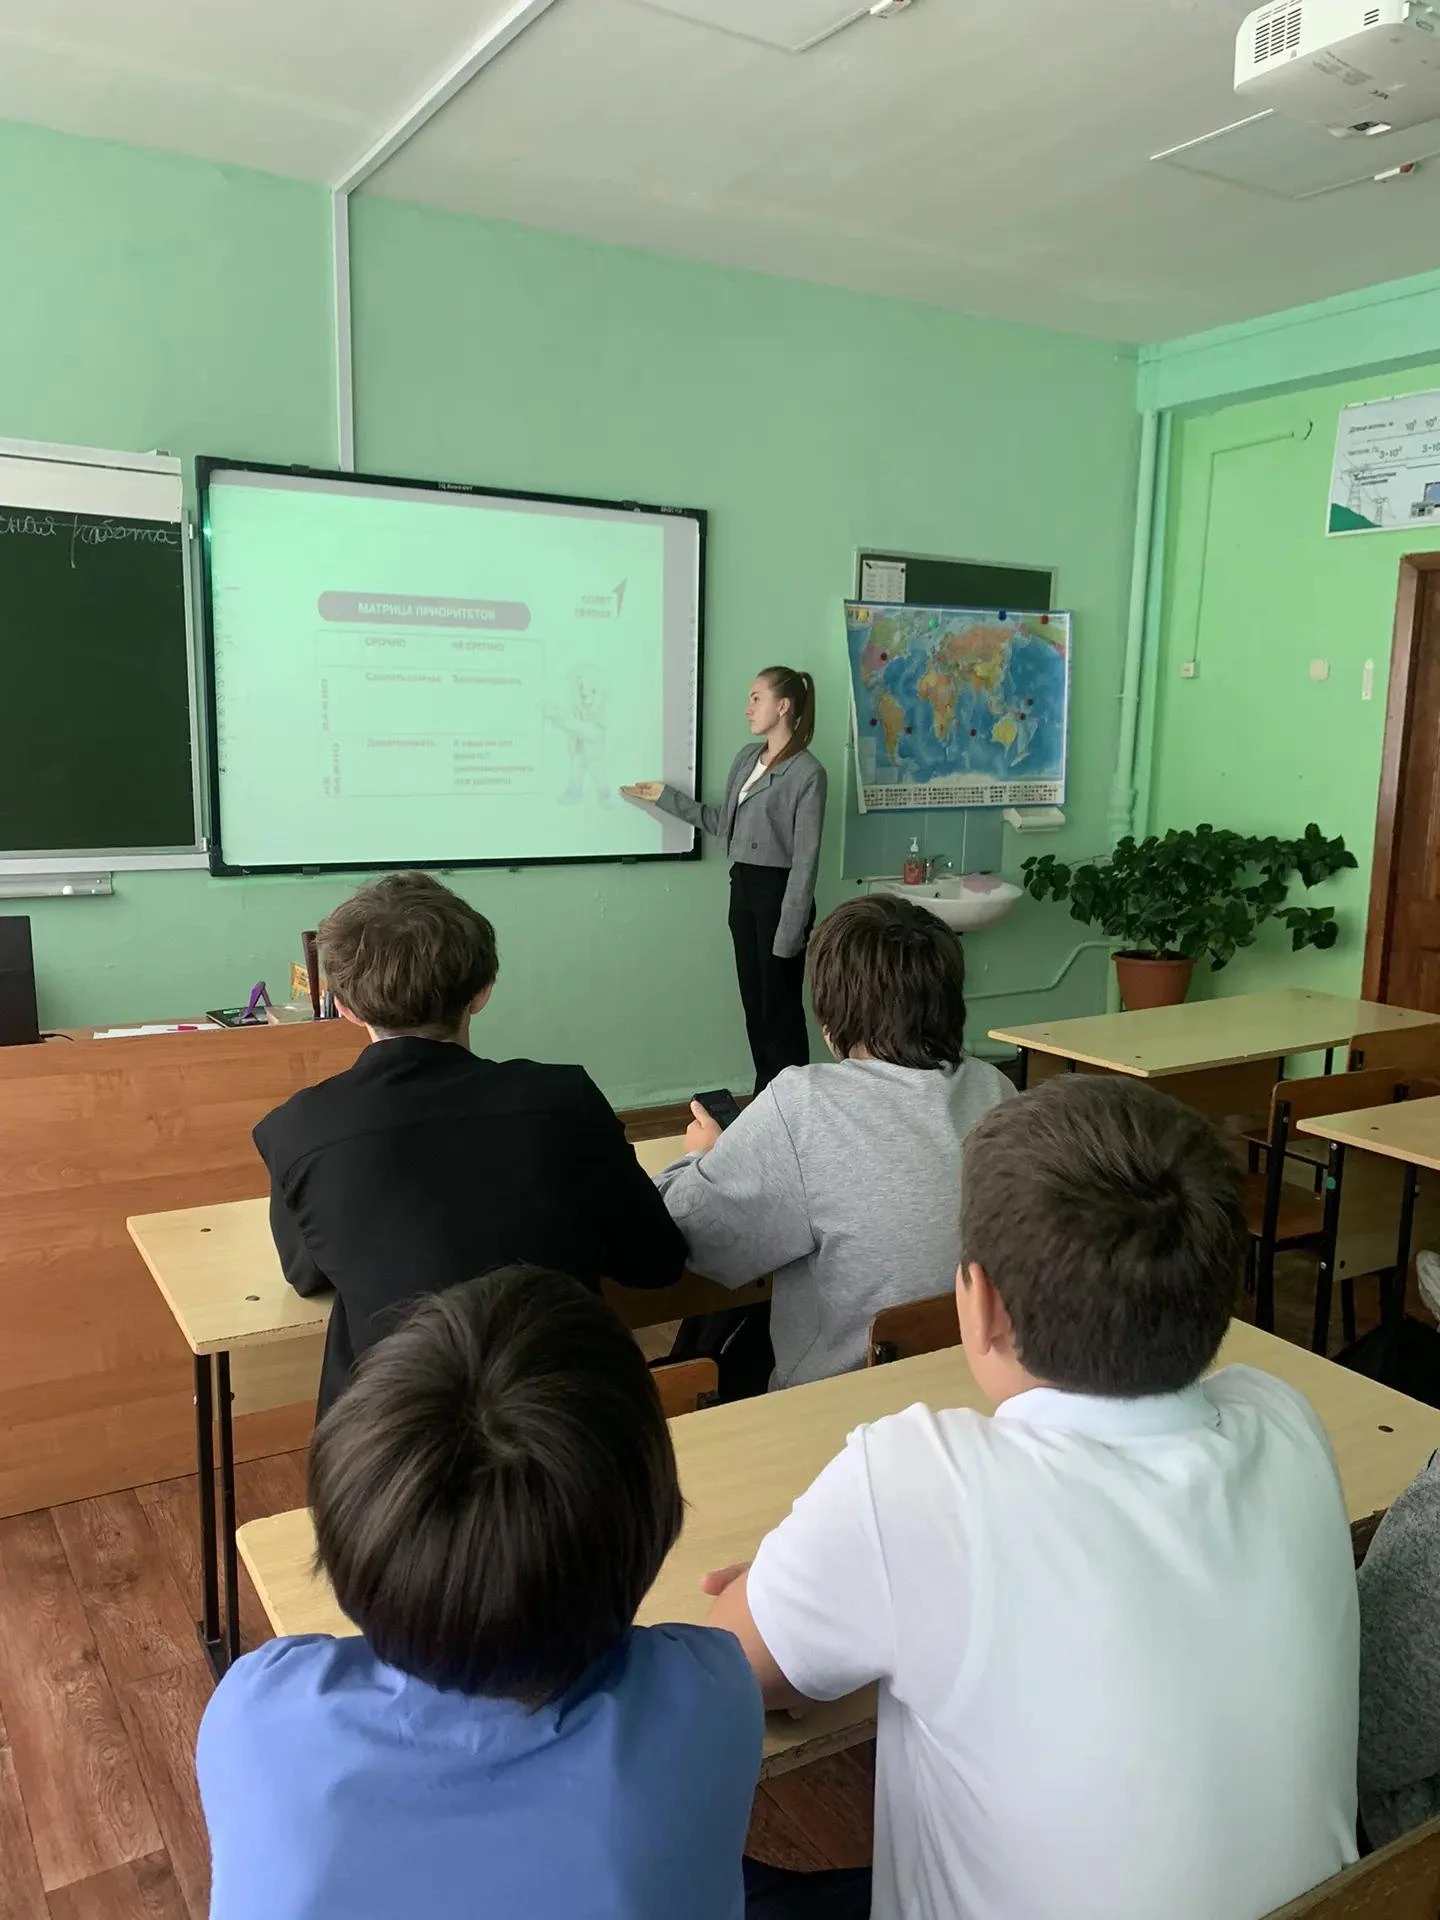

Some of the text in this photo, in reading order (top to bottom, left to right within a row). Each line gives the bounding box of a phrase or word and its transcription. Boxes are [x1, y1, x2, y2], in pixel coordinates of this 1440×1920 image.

[70, 514, 178, 568] работа
[358, 601, 496, 621] МАТРИЦА ПРИОРИТЕТОВ
[364, 636, 408, 648] СРОЧНО
[467, 641, 506, 652] СРОЧНО
